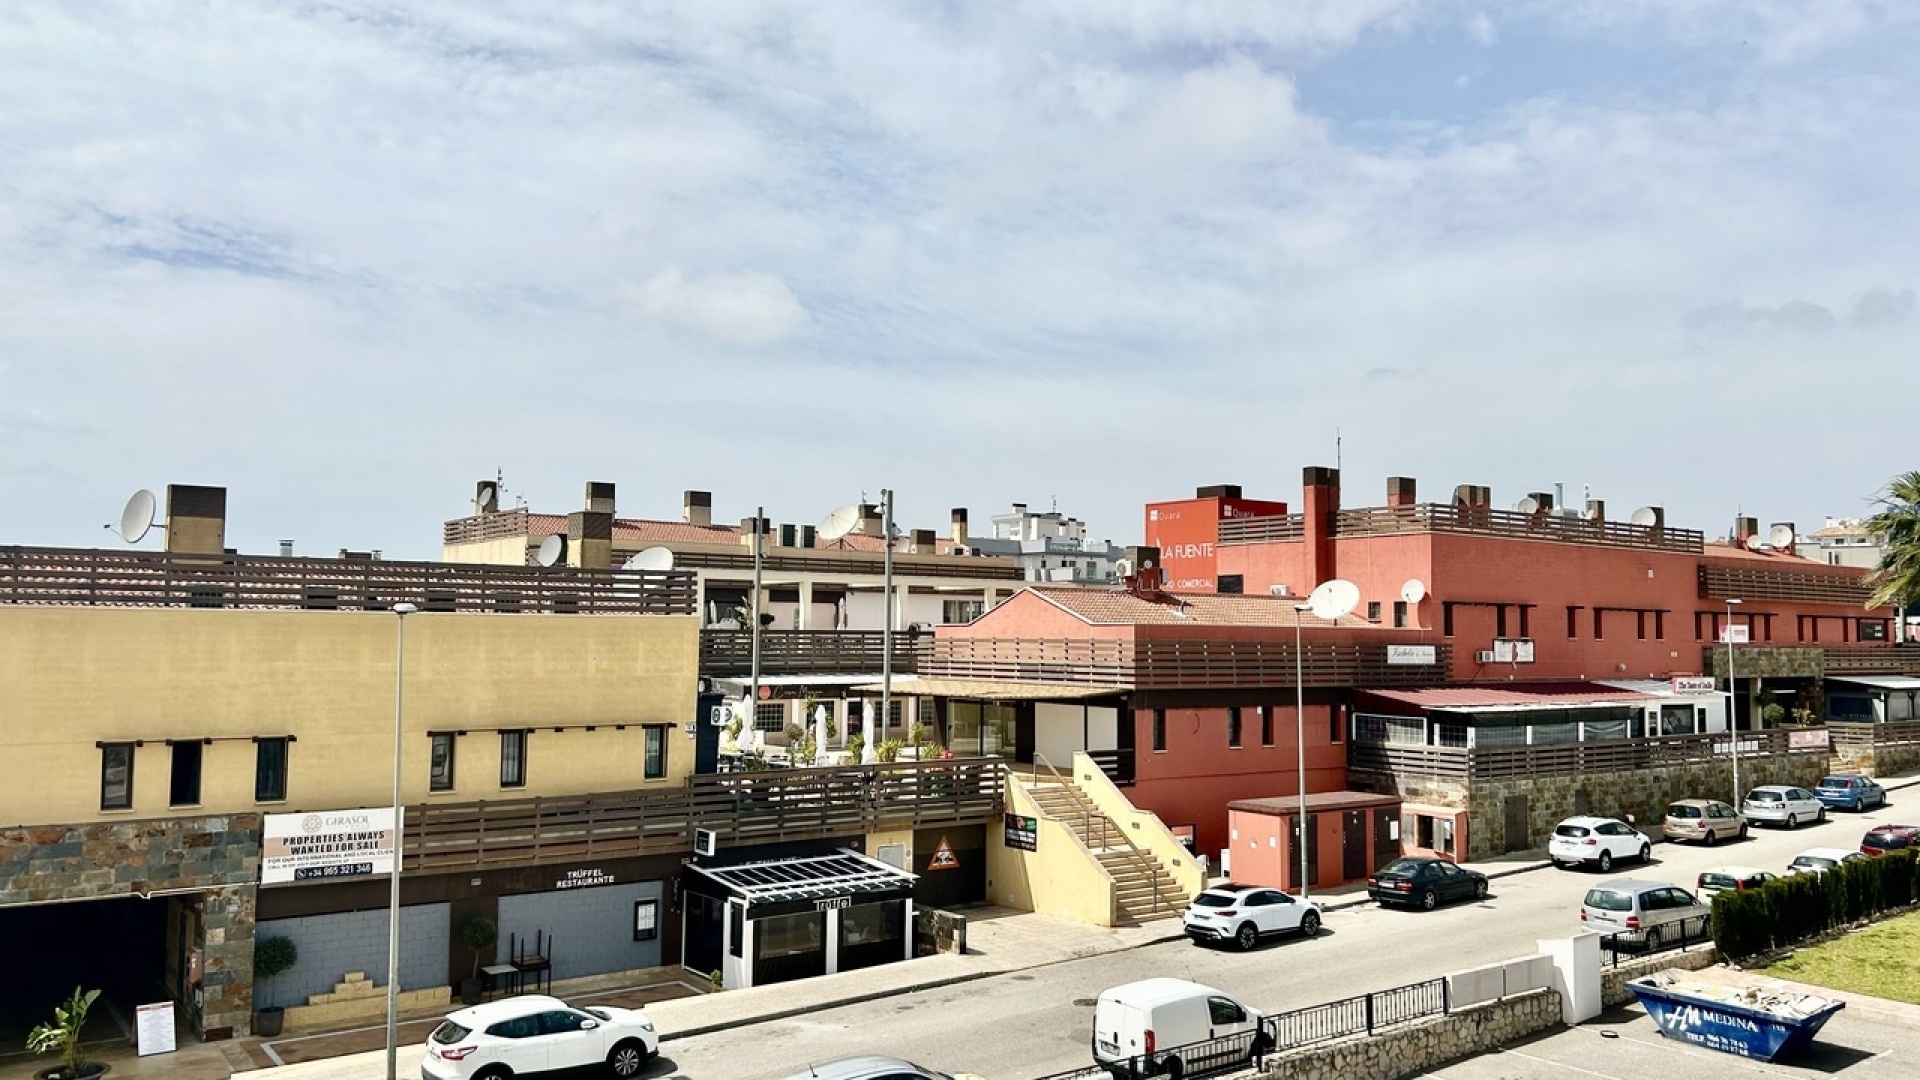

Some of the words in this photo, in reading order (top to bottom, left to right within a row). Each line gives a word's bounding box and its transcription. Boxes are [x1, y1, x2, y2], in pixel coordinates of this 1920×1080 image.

[1160, 545, 1174, 559] LA
[1175, 543, 1214, 558] FUENTE
[1178, 578, 1214, 589] COMERCIAL
[325, 815, 369, 826] GIRASOL
[283, 833, 343, 846] PROPERTIES
[347, 830, 385, 841] ALWAYS
[291, 844, 332, 855] WANTED
[336, 843, 354, 852] FOR
[357, 840, 379, 850] SALE
[308, 868, 322, 877] +34
[340, 865, 354, 874] 321
[556, 875, 615, 888] RESTAURANTE
[1703, 1010, 1759, 1033] MEDINA
